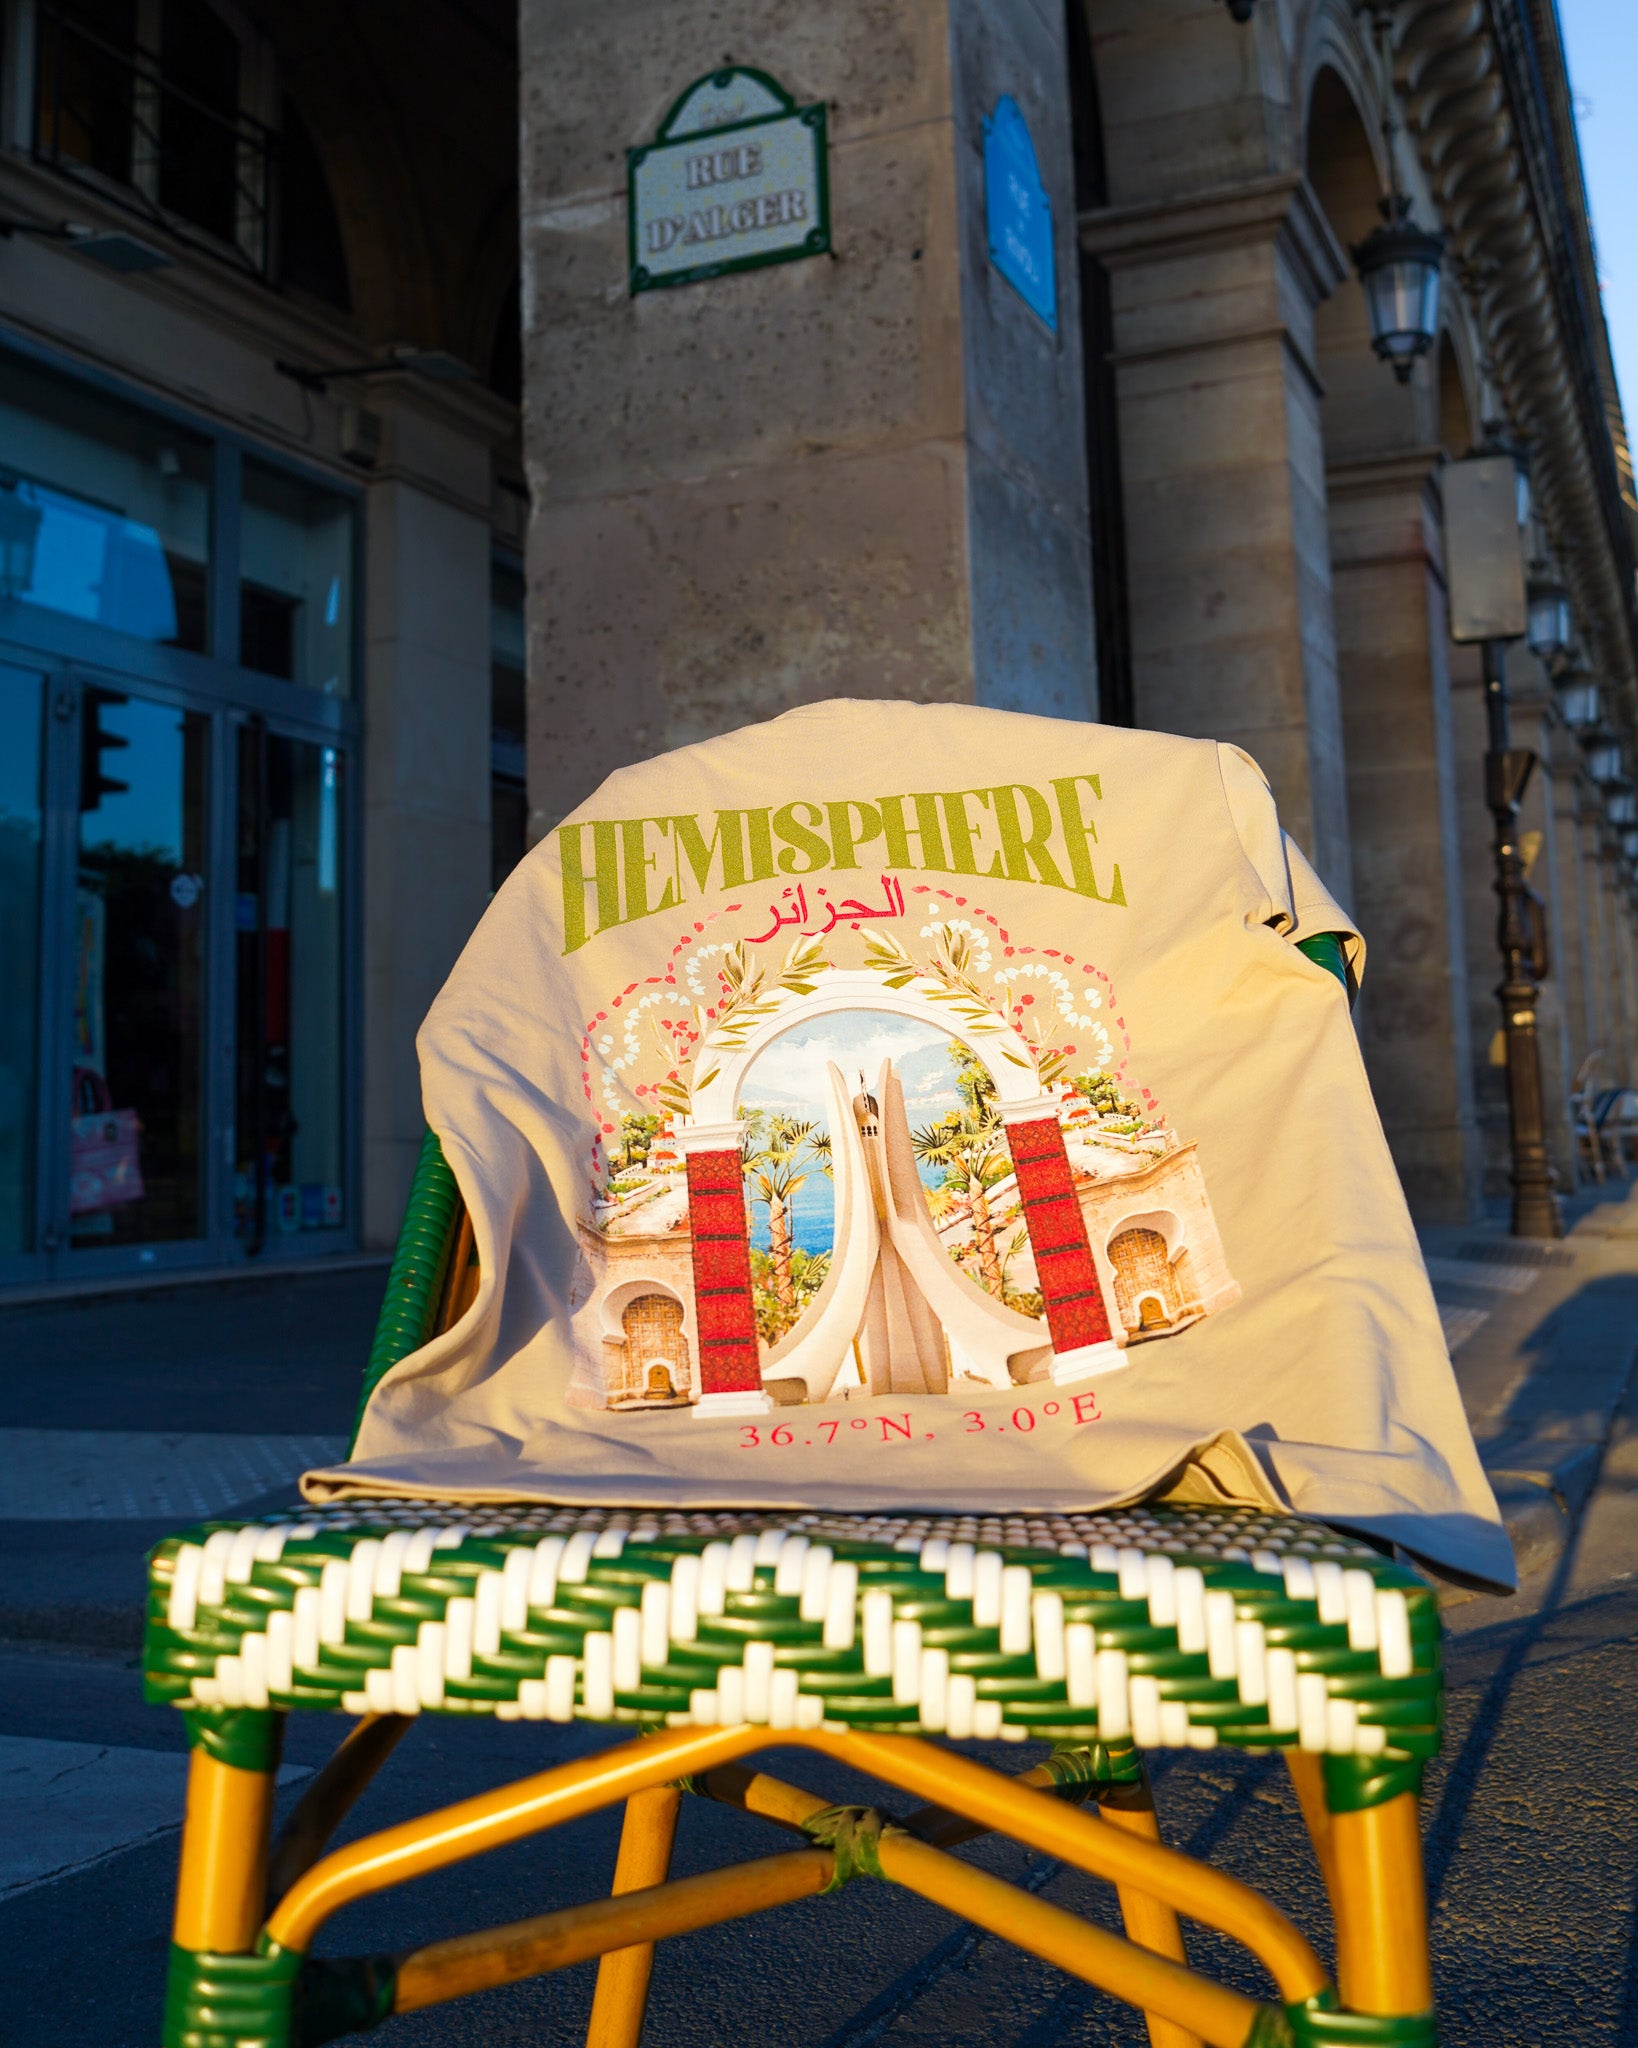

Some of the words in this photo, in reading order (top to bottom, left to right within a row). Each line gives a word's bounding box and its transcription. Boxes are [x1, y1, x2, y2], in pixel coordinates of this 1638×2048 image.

[685, 142, 764, 191] RUE
[647, 188, 807, 254] D'ALGER
[555, 773, 1128, 957] HEMISPHERE
[744, 874, 905, 943] الجزائر
[739, 1413, 935, 1448] 36.7°N,
[963, 1391, 1102, 1432] 3.0°E
